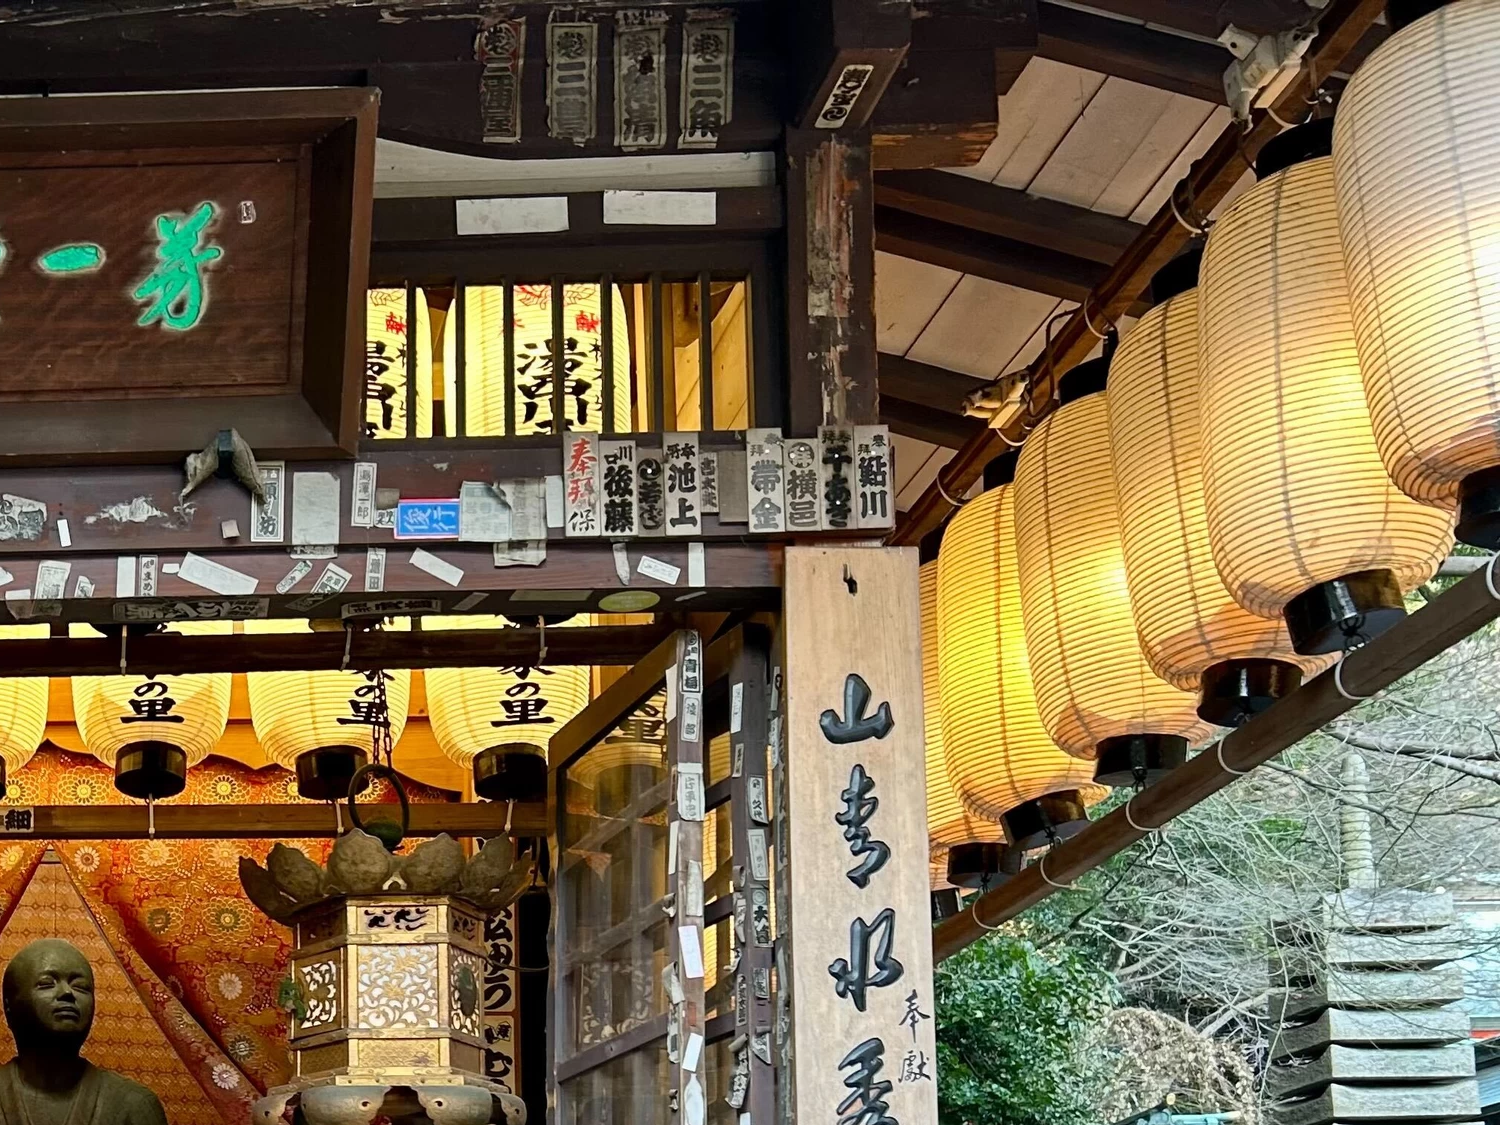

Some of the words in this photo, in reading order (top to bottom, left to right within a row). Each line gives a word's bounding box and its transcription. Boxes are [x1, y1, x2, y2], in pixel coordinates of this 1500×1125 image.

[603, 466, 635, 533] 後藤
[668, 462, 698, 528] 池上
[119, 681, 185, 724] の里
